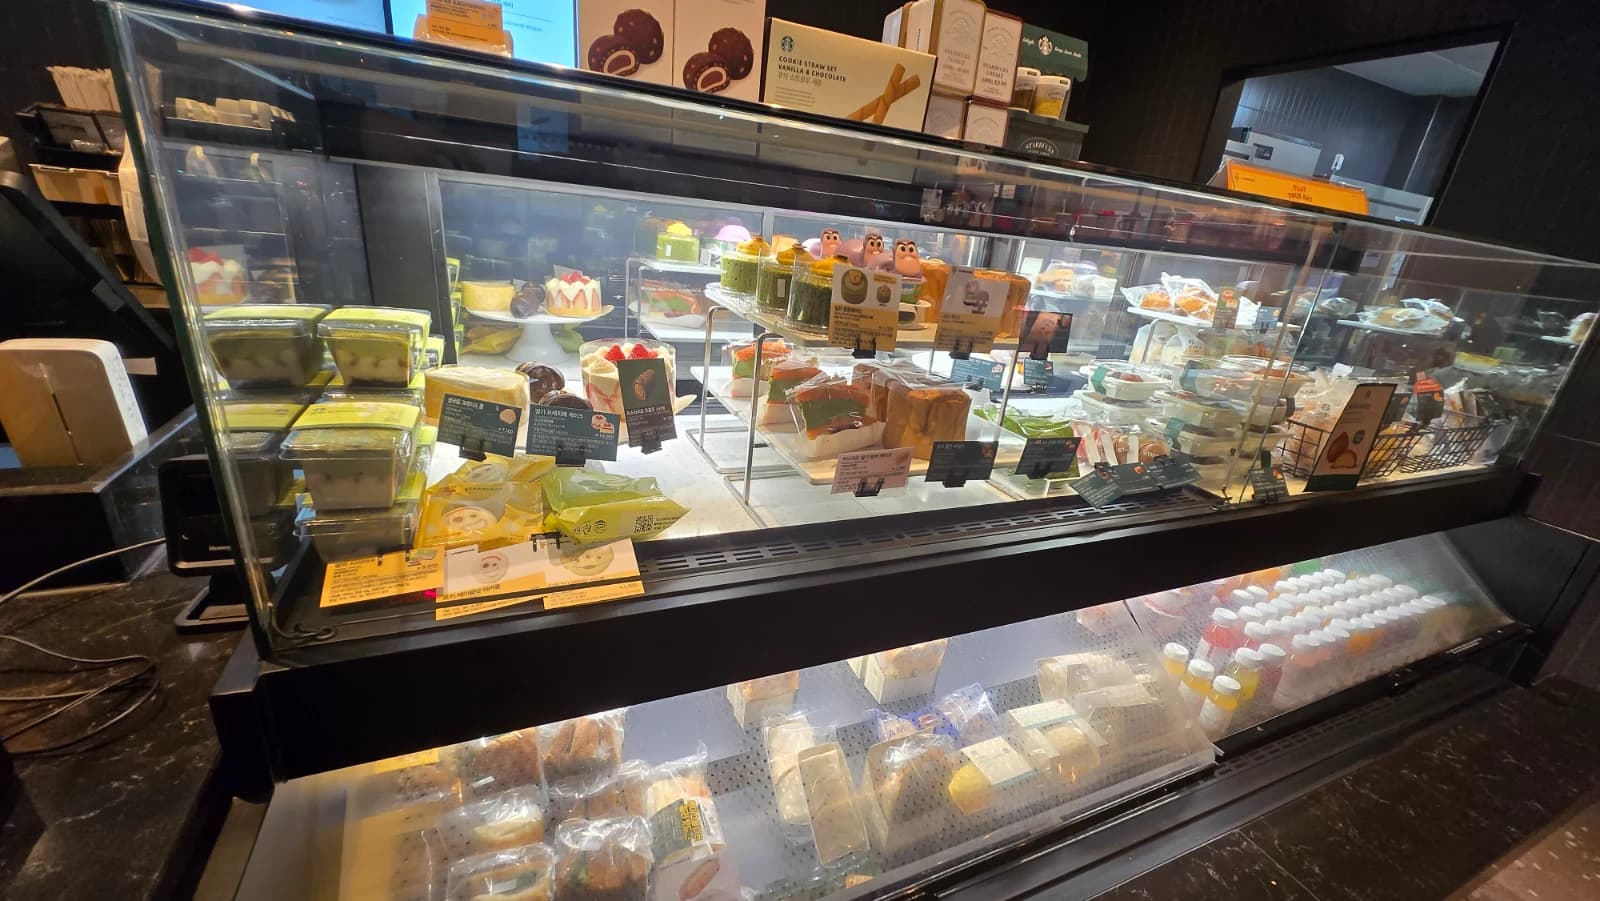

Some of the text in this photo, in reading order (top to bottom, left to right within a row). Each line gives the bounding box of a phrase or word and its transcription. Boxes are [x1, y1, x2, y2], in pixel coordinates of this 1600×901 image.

[779, 56, 802, 65] COOKIE
[804, 61, 825, 70] STRAW
[778, 64, 804, 74] VANILLA
[811, 70, 846, 82] CHOCOLATE
